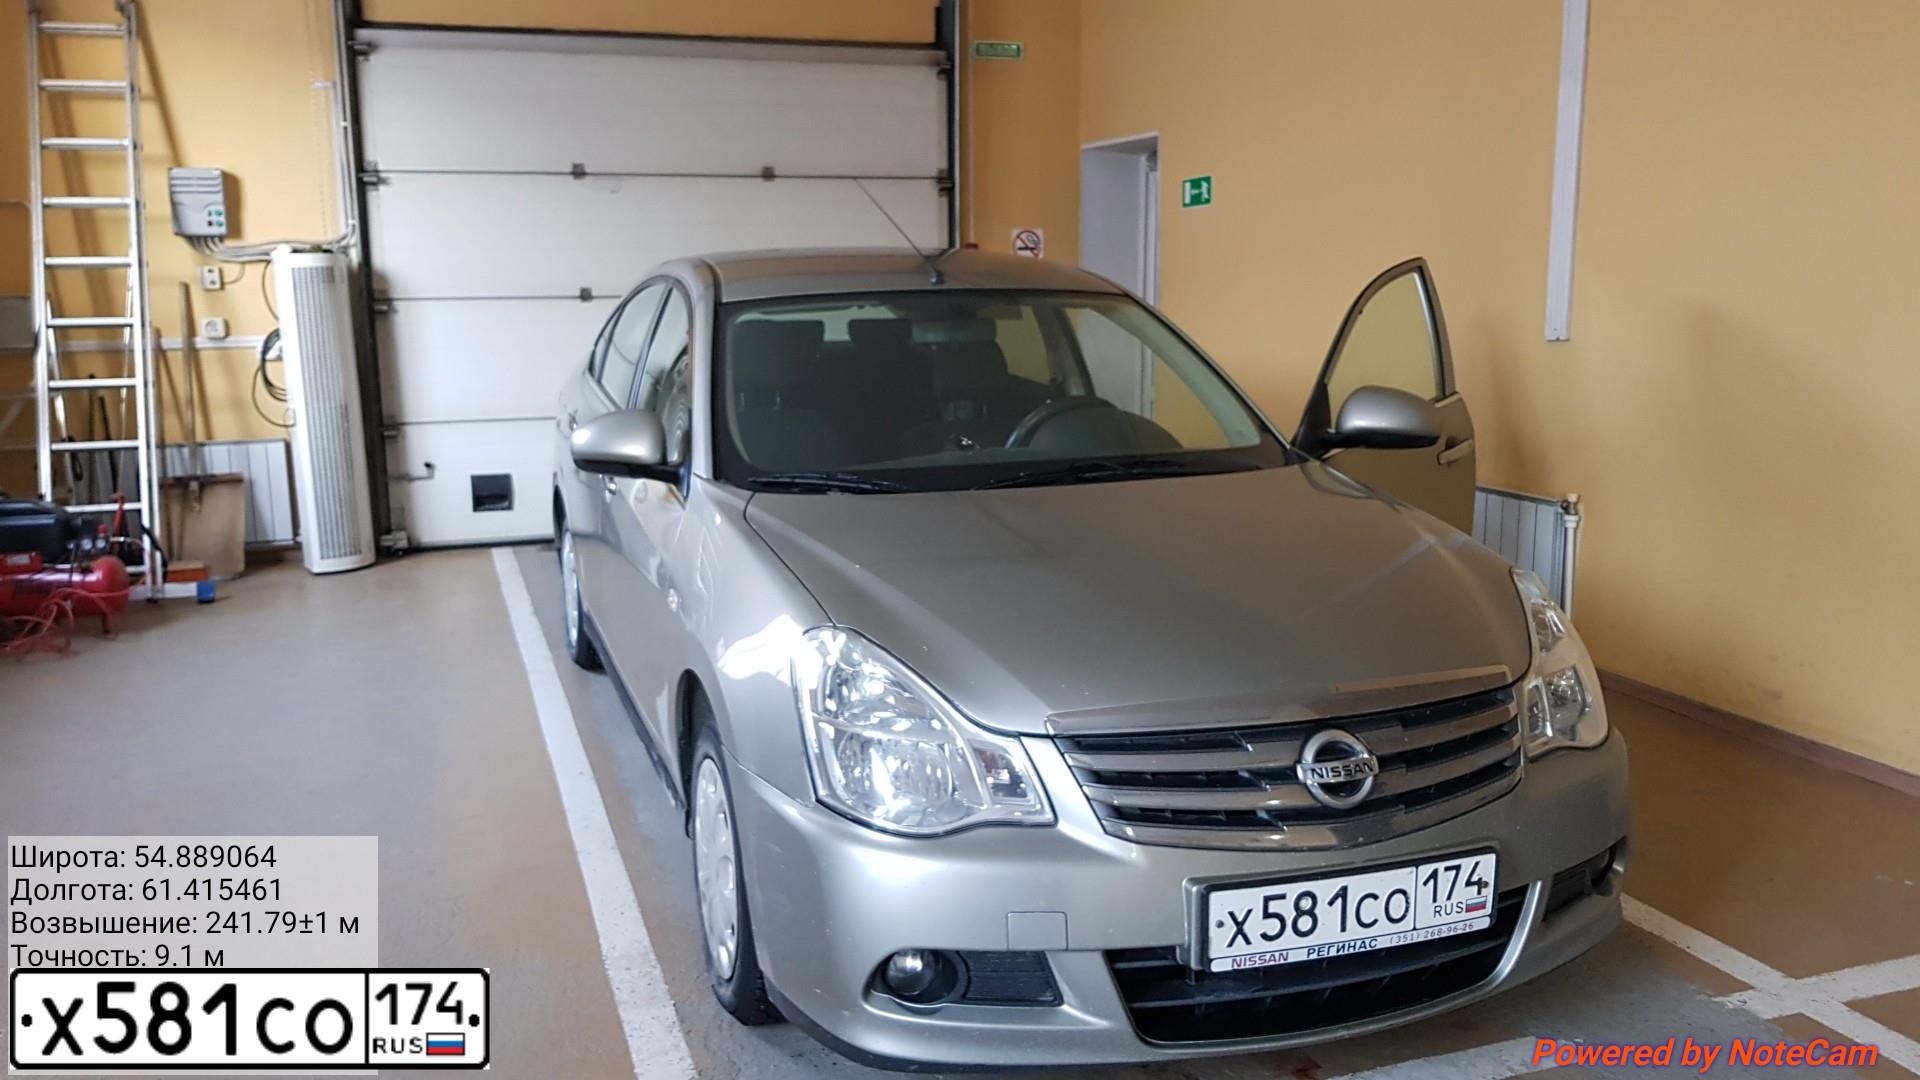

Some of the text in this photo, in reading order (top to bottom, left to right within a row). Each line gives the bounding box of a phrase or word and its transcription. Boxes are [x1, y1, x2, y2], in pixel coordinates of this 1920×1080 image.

[1310, 762, 1374, 779] NISSAN
[1422, 860, 1484, 904] 174
[1433, 901, 1464, 918] RUS
[1231, 952, 1289, 969] NISSAN
[1306, 938, 1378, 959] РЕГИНАС
